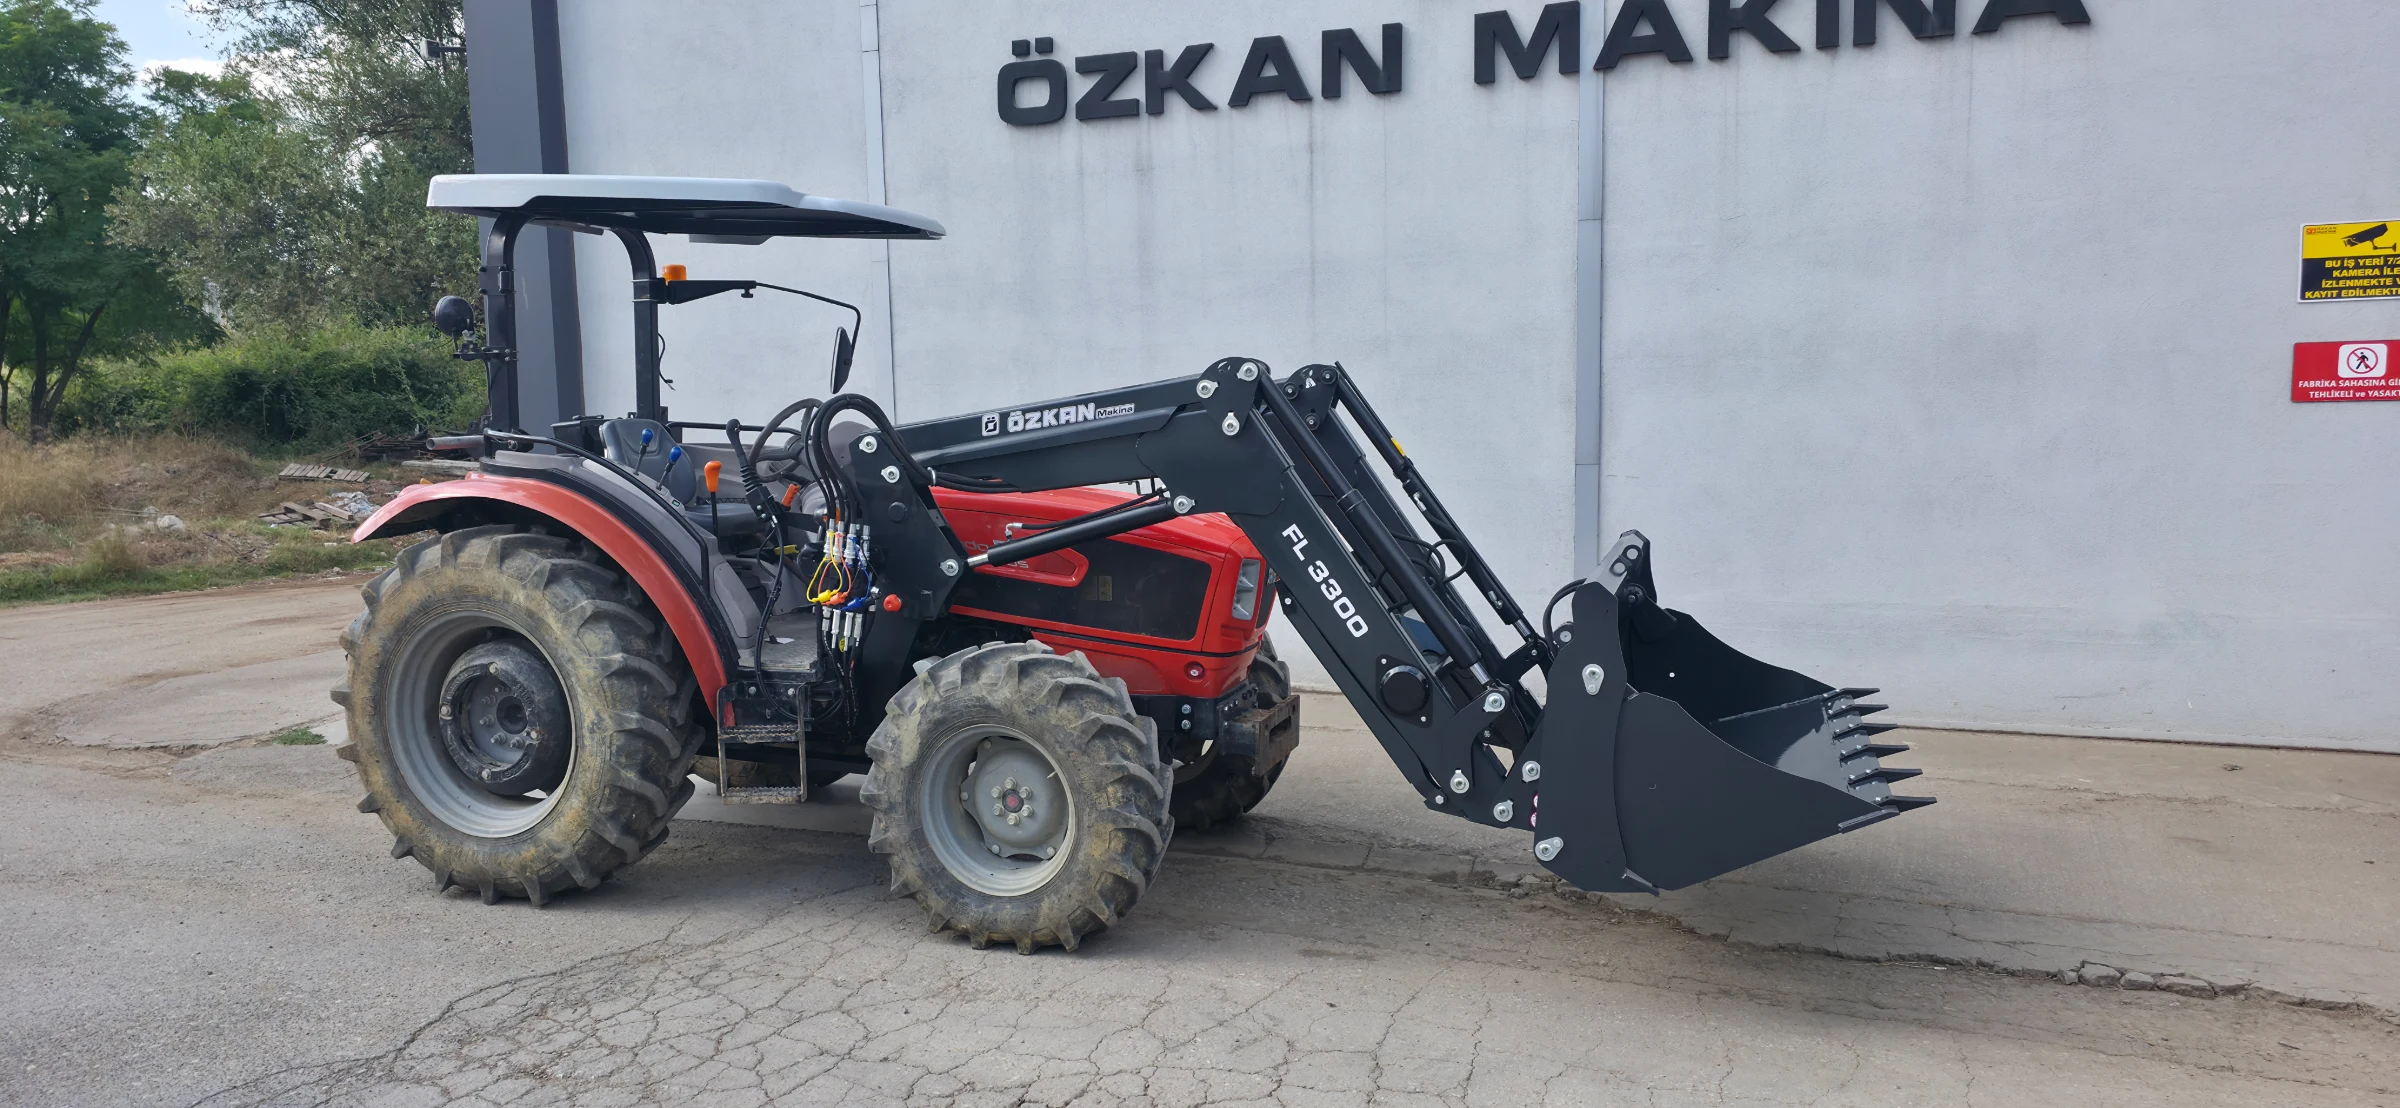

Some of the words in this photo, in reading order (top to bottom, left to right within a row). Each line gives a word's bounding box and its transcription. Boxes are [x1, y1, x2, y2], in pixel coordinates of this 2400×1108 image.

[997, 22, 1403, 126] ÖZKAN
[2325, 260, 2341, 268] BU
[2343, 257, 2355, 269] İŞ
[2358, 256, 2384, 266] YERİ
[2332, 268, 2380, 277] KAMERA
[2383, 266, 2400, 275] İLE
[2321, 278, 2393, 288] İZLENMEKTE
[2305, 290, 2339, 299] KAYIT
[2341, 287, 2400, 297] EDİLMEKT
[2298, 378, 2337, 388] FABRİKA
[2338, 378, 2386, 387] SAHASINA
[2388, 378, 2400, 386] Gİ
[2309, 389, 2354, 399] TEHLİKELİ
[1006, 402, 1096, 433] ÖZKAN
[1097, 404, 1134, 418] Makina
[1281, 523, 1309, 561] FL
[1307, 560, 1369, 638] 3300
